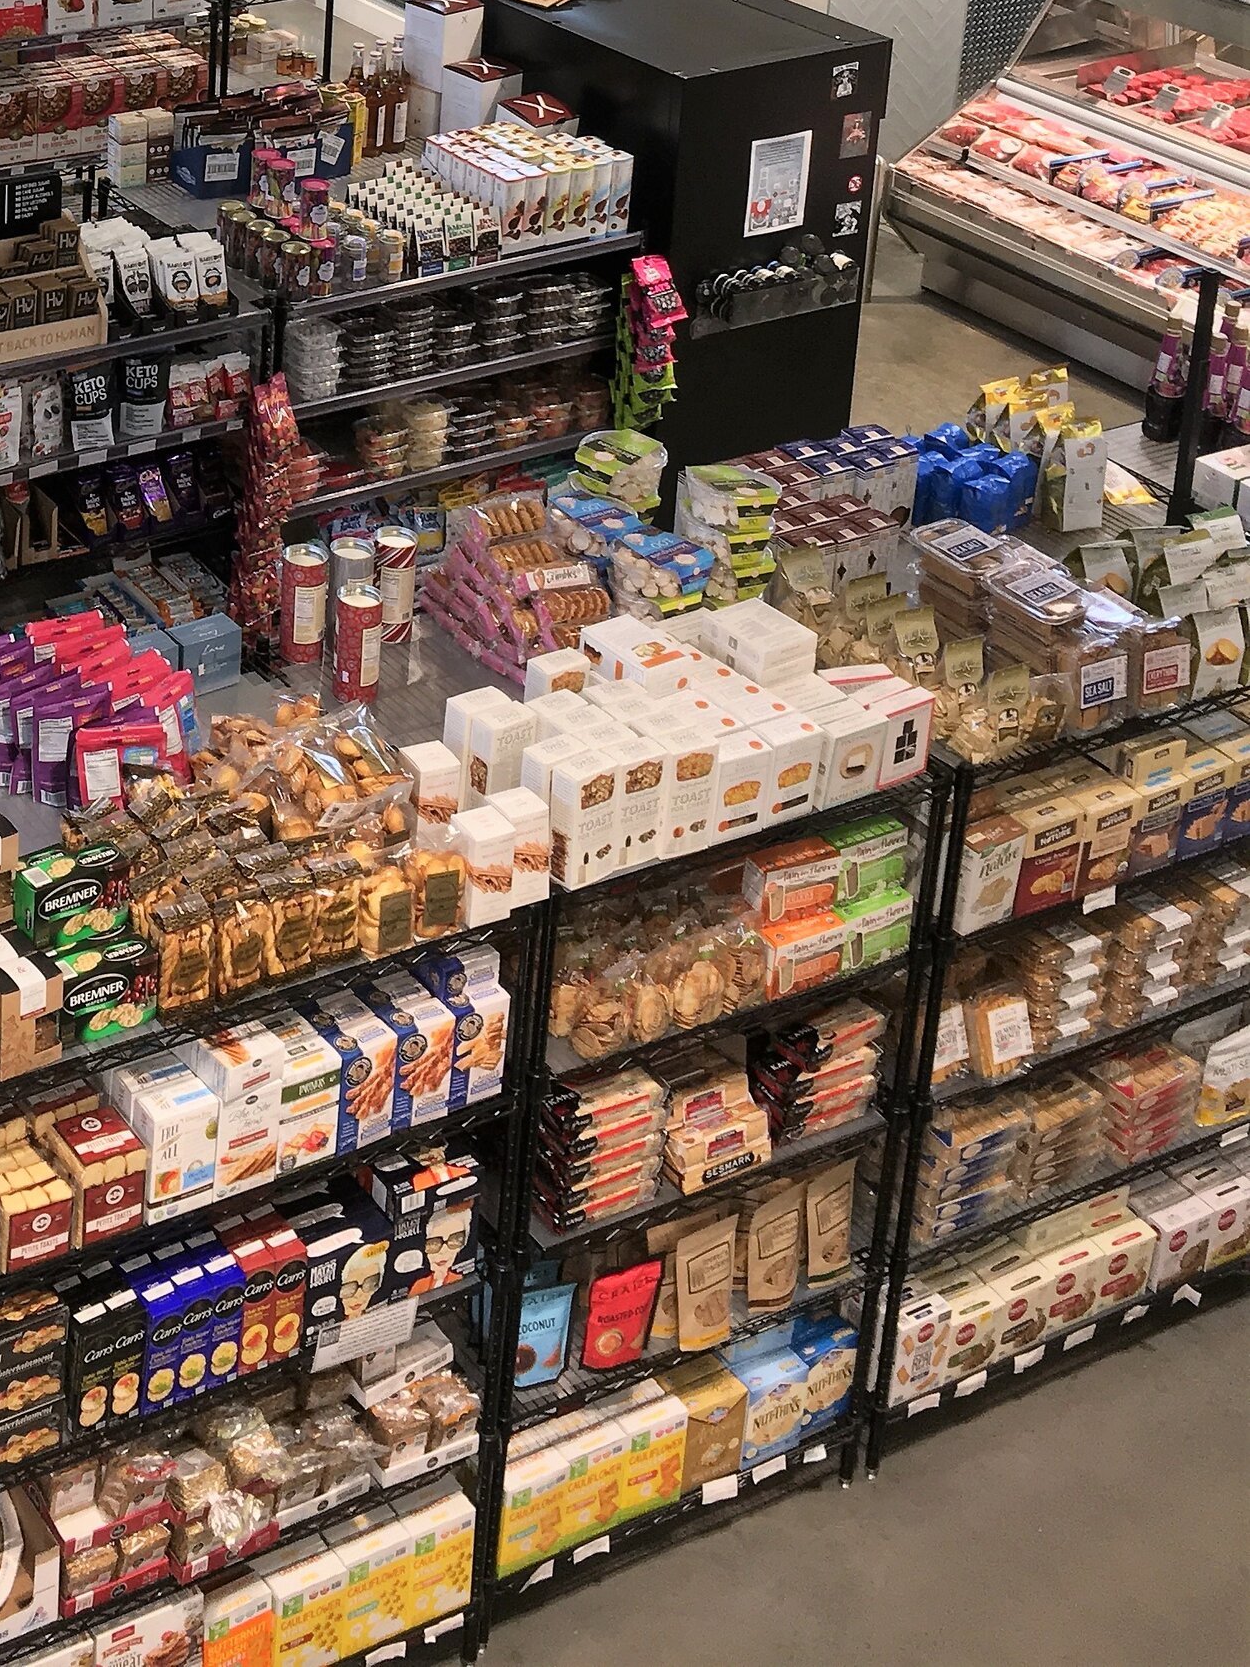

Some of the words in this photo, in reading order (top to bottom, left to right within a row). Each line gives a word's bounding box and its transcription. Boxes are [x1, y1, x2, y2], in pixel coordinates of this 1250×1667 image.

[7, 337, 37, 352] BACK
[40, 333, 54, 347] TO
[125, 364, 159, 379] KETO
[125, 374, 159, 390] CUPS
[74, 375, 106, 395] KETO
[74, 388, 108, 407] CUPS
[1084, 682, 1098, 698] SEA
[1097, 677, 1114, 694] SALT
[671, 786, 712, 807] TOAST
[621, 798, 660, 817] TOAST
[579, 812, 614, 833] TOAST
[44, 884, 98, 912] BREMNER
[69, 979, 125, 1007] BREMNER
[705, 1153, 752, 1181] SESMARK
[277, 1268, 307, 1288] Carr's
[245, 1280, 275, 1299] Carr's
[215, 1294, 245, 1314] Carr's
[183, 1307, 213, 1327] Carr's
[116, 1330, 146, 1351] Carr's
[152, 1322, 182, 1343] Carr's
[84, 1342, 114, 1364] Carr's
[412, 1539, 473, 1570] CAULIFLOWER
[347, 1567, 407, 1598] CAULIFLOWER
[280, 1599, 342, 1631] CAULIFLOWER
